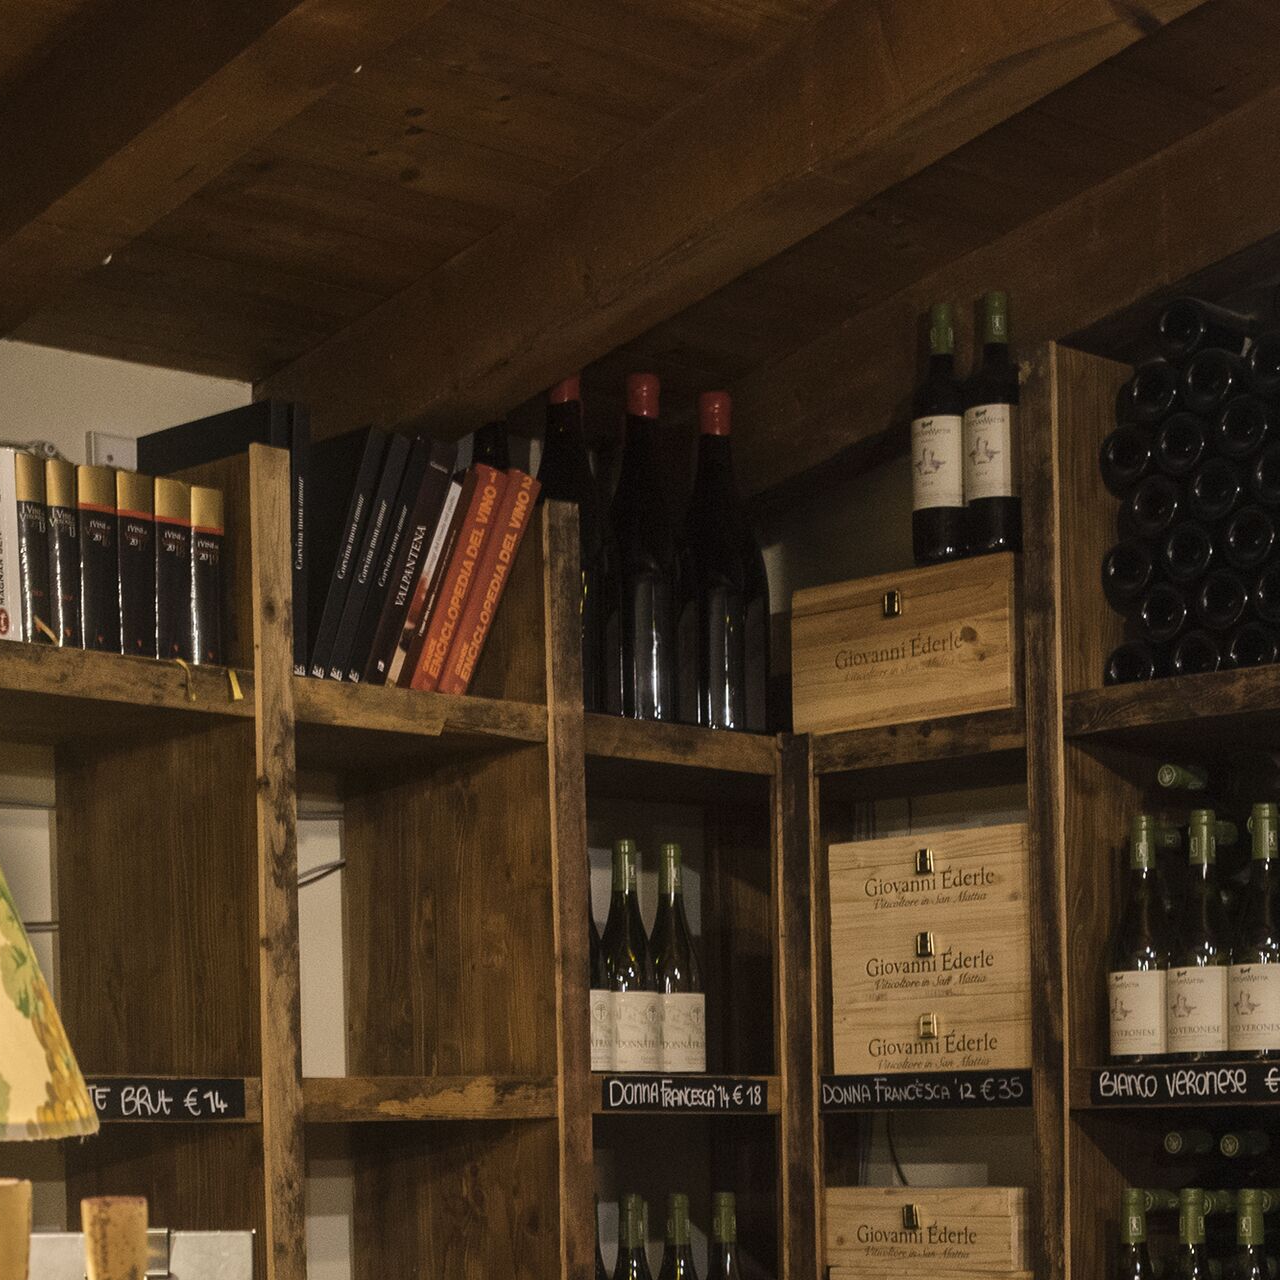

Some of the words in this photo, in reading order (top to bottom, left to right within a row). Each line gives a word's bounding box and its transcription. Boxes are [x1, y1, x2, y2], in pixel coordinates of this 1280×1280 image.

[476, 485, 498, 525] VINO
[468, 528, 485, 562] DEL
[394, 525, 426, 607] VALPANTENA
[459, 565, 507, 683] ENCICLOPEDIA
[500, 532, 518, 566] DEL
[509, 490, 531, 529] VINO
[429, 560, 475, 680] ENCICLOPEDIA
[834, 641, 906, 670] Giovanni
[864, 877, 936, 898] Giovanni
[866, 957, 937, 978] Giovanni
[868, 1038, 940, 1058] Giovanni
[822, 1083, 871, 1105] DONNA
[873, 1077, 951, 1100] FRANCESCA
[856, 1224, 924, 1245] Giovanni
